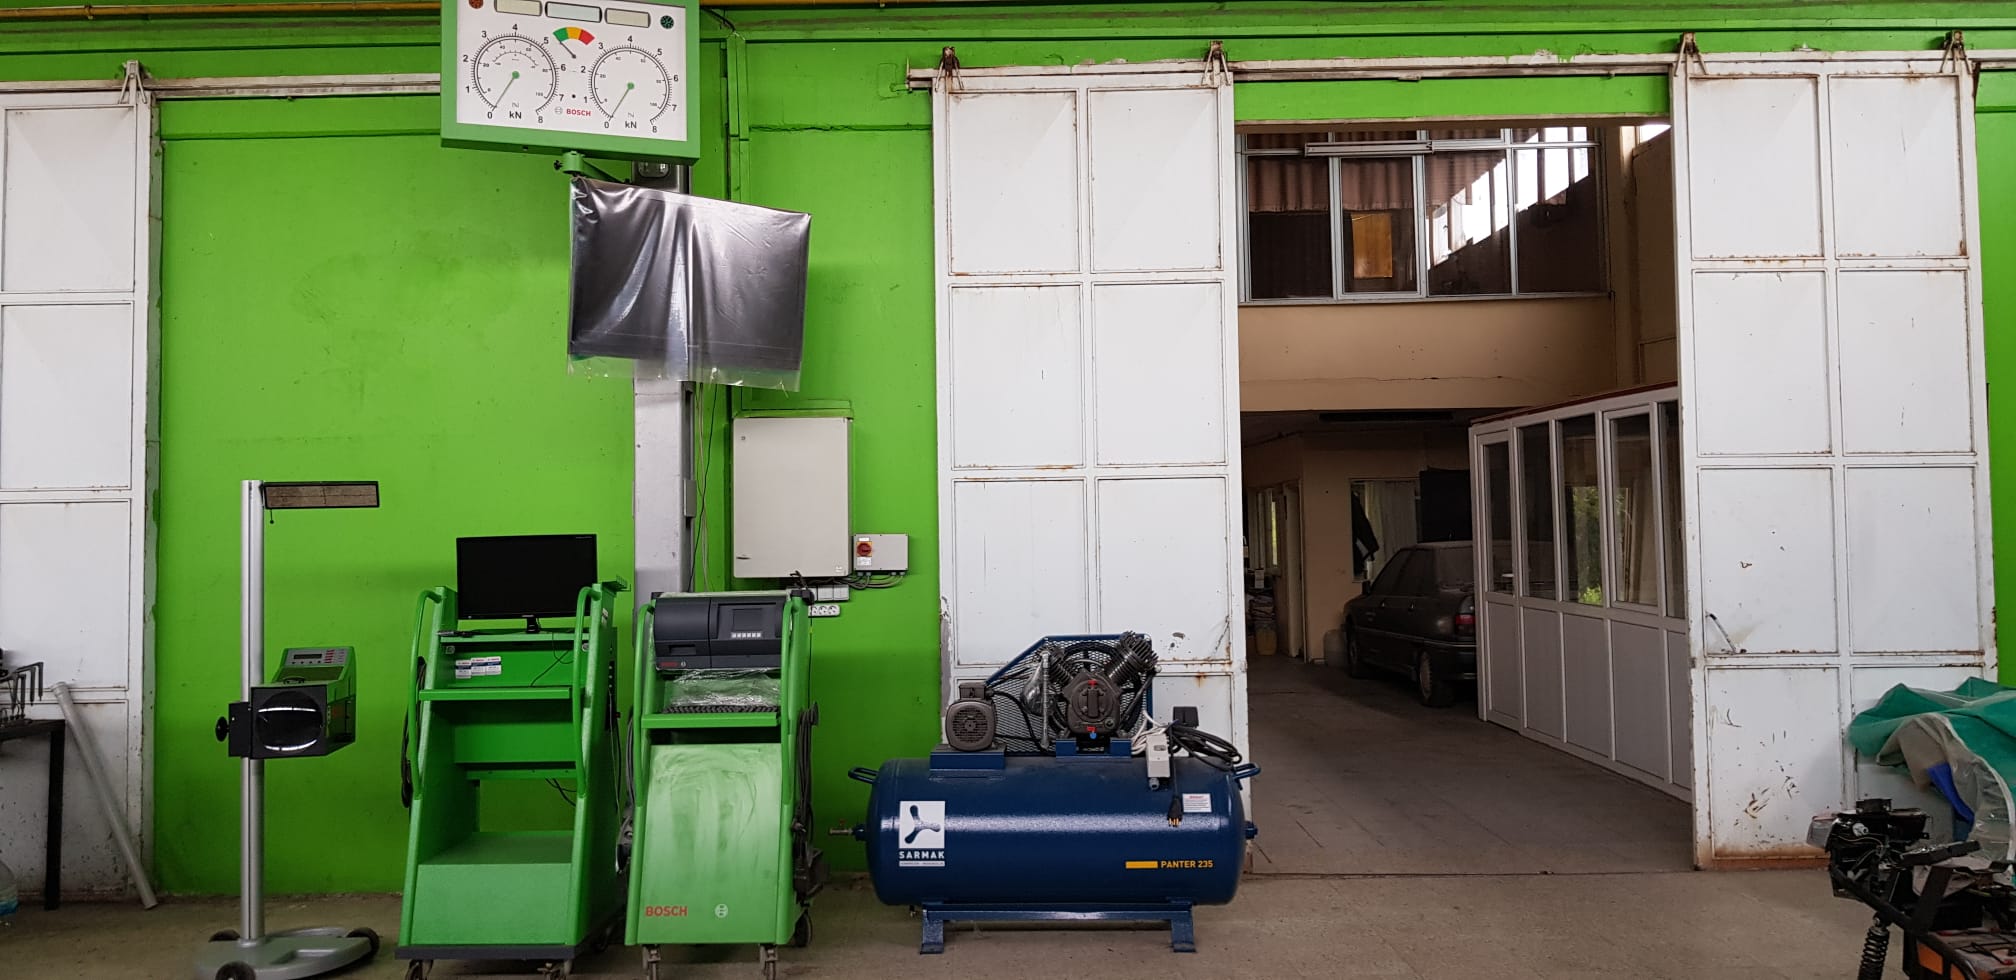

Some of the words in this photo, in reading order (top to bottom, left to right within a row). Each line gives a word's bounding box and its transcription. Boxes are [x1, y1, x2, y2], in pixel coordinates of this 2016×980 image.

[512, 23, 518, 31] 4
[481, 30, 487, 38] 3
[543, 36, 549, 44] 5
[598, 42, 604, 50] 3
[657, 48, 663, 56] 5
[462, 54, 469, 62] 2
[560, 63, 567, 71] 6
[580, 65, 586, 73] 2
[673, 74, 679, 82] 6
[559, 93, 565, 101] 7
[672, 104, 677, 112] 7
[487, 111, 493, 119] 0
[509, 110, 522, 119] kN
[566, 108, 591, 117] BOSCH
[537, 115, 544, 124] 8
[604, 121, 610, 129] 0
[624, 120, 637, 129] kN
[652, 125, 658, 134] 8
[898, 850, 945, 859] SARMAK
[1160, 860, 1197, 869] PANTER
[1198, 859, 1214, 868] 235
[645, 905, 688, 917] BOSCH
